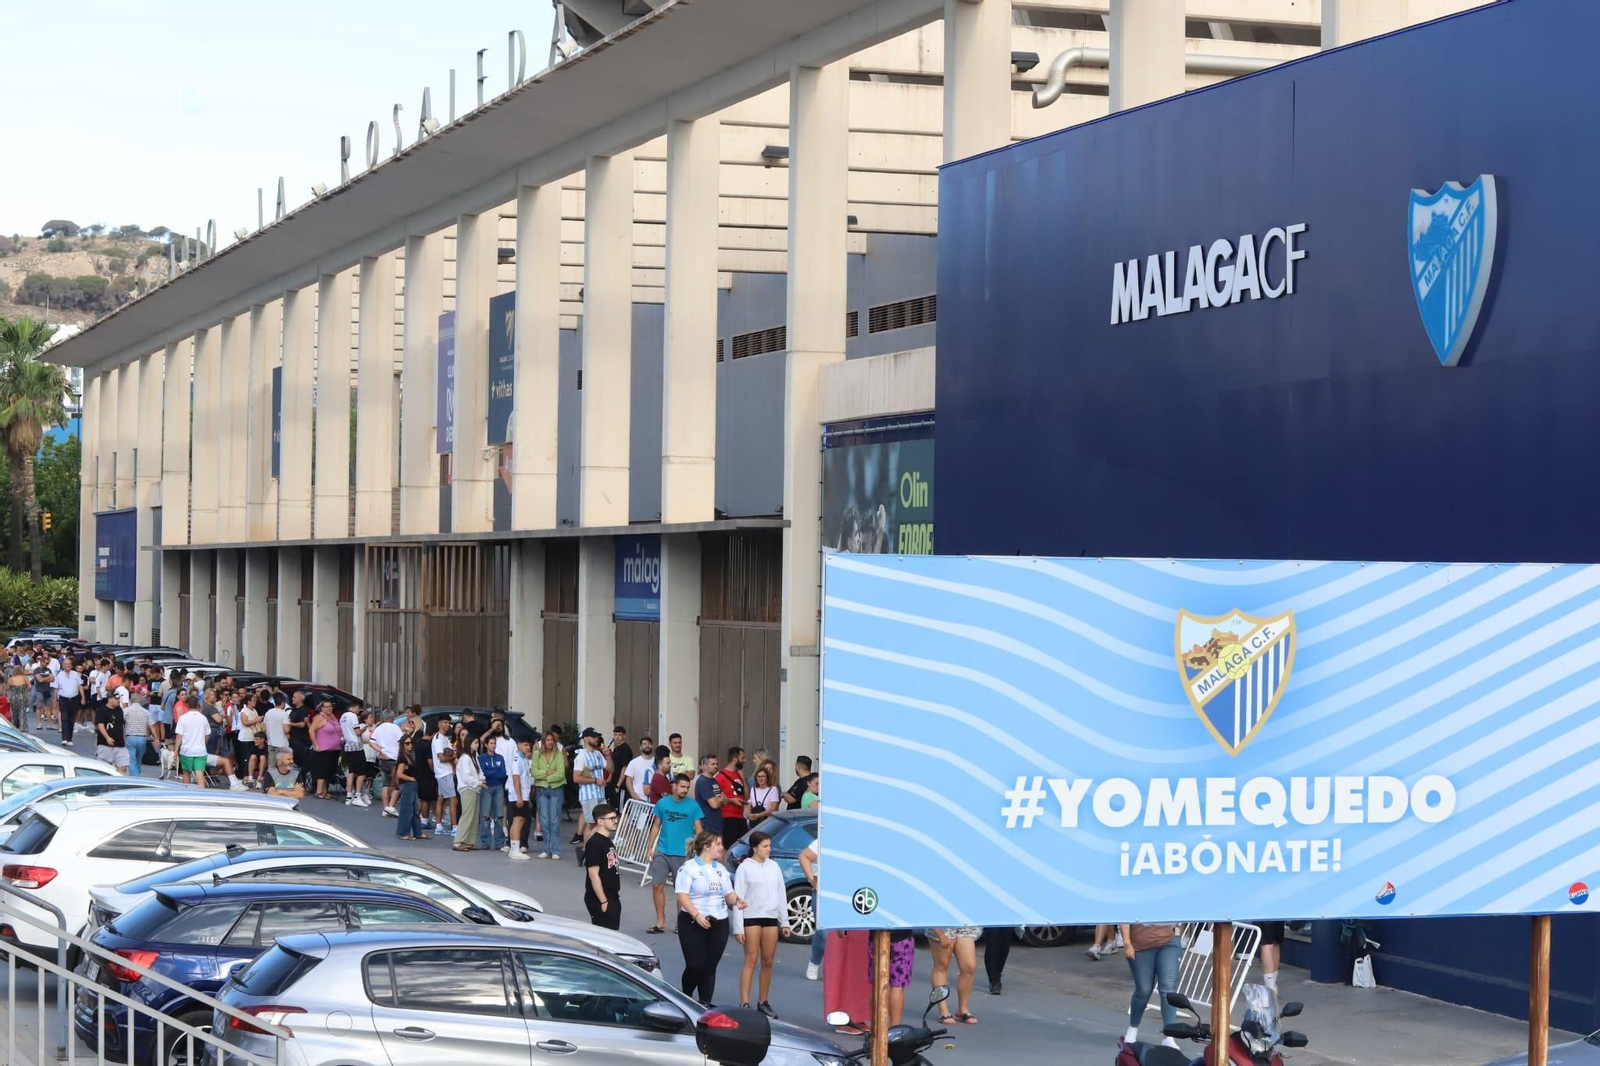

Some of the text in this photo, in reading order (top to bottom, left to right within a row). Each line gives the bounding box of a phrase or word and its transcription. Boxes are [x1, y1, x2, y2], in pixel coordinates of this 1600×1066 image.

[1111, 223, 1306, 325] MALAGACF
[1423, 227, 1460, 288] MAAGA
[1197, 646, 1252, 695] MALAGA
[1001, 774, 1457, 829] #YOMEQUEDO
[1120, 834, 1342, 876] ¡ABÓNATE!
